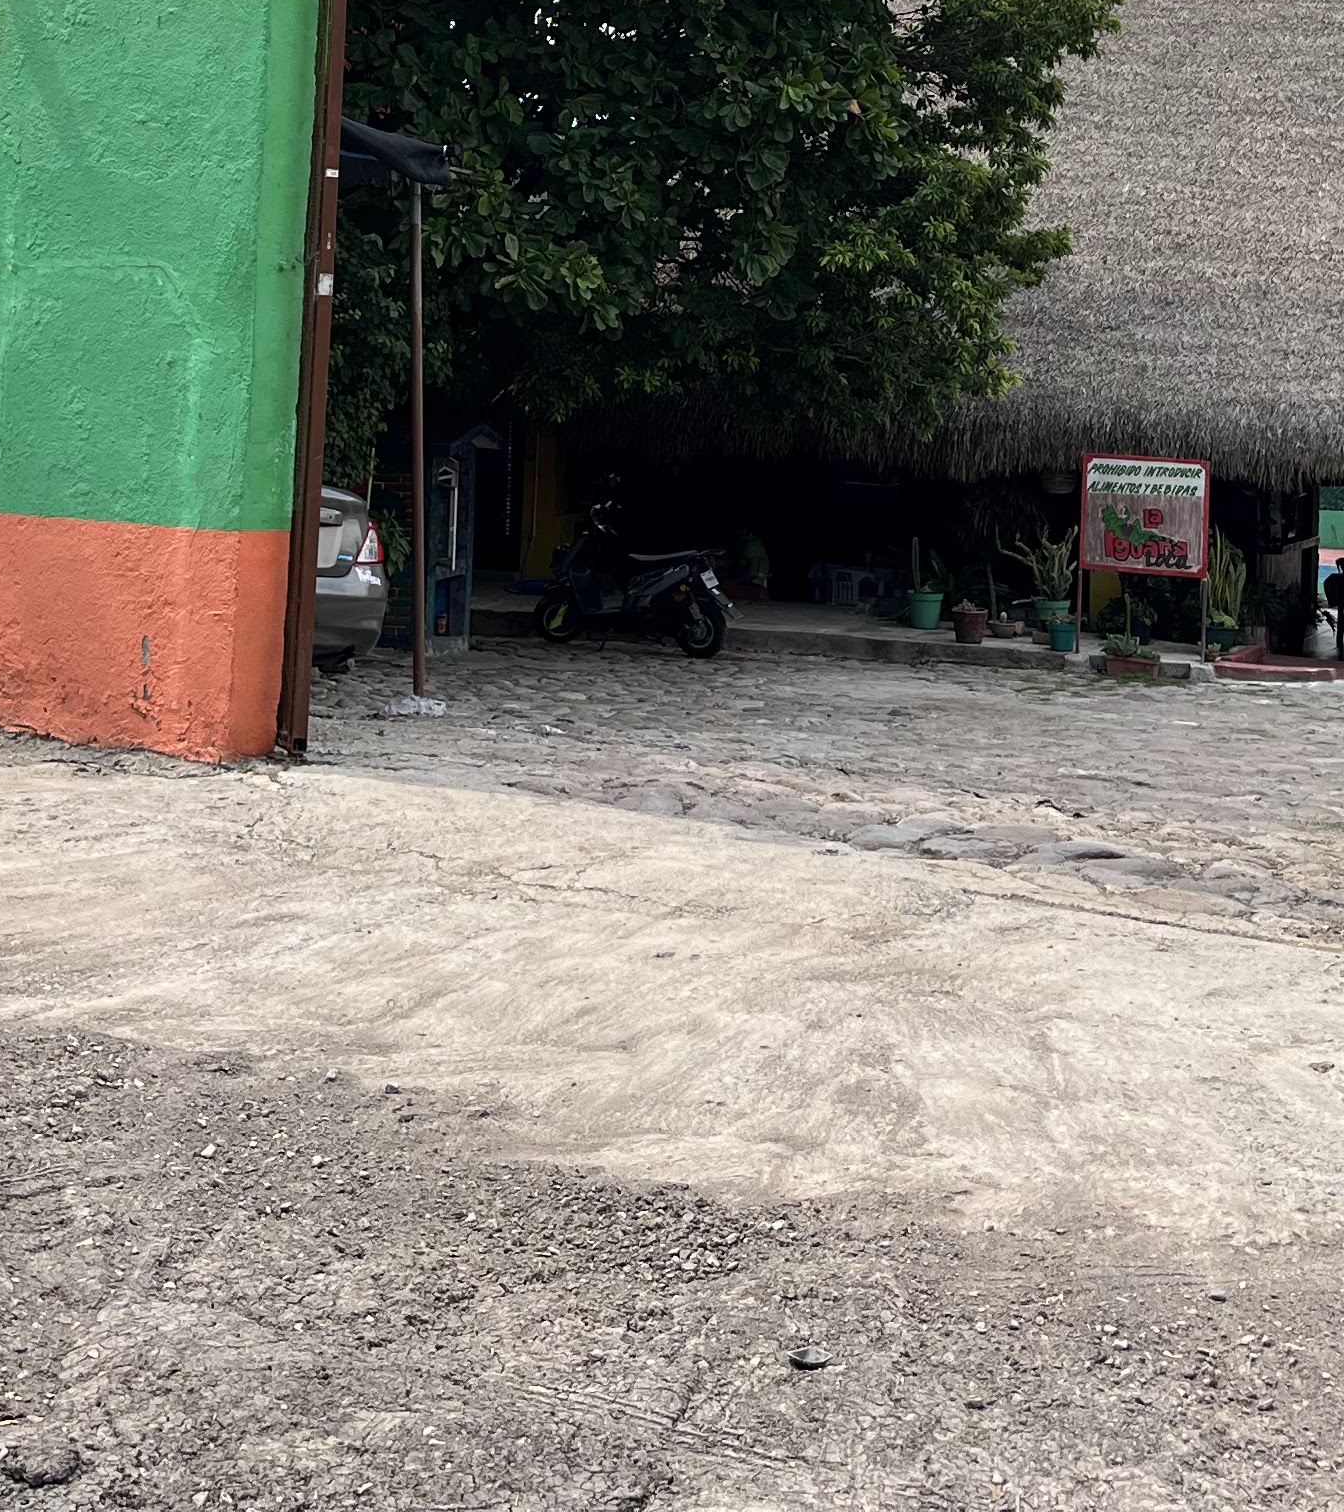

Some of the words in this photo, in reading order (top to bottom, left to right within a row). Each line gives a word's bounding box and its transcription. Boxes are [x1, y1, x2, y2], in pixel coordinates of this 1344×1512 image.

[1087, 462, 1142, 477] PROHIBIDO
[1143, 465, 1203, 479] INTRODUCIR
[1087, 480, 1142, 494] ALIMENTOS
[1143, 483, 1151, 495] Y
[1150, 483, 1199, 497] BEBIDAS
